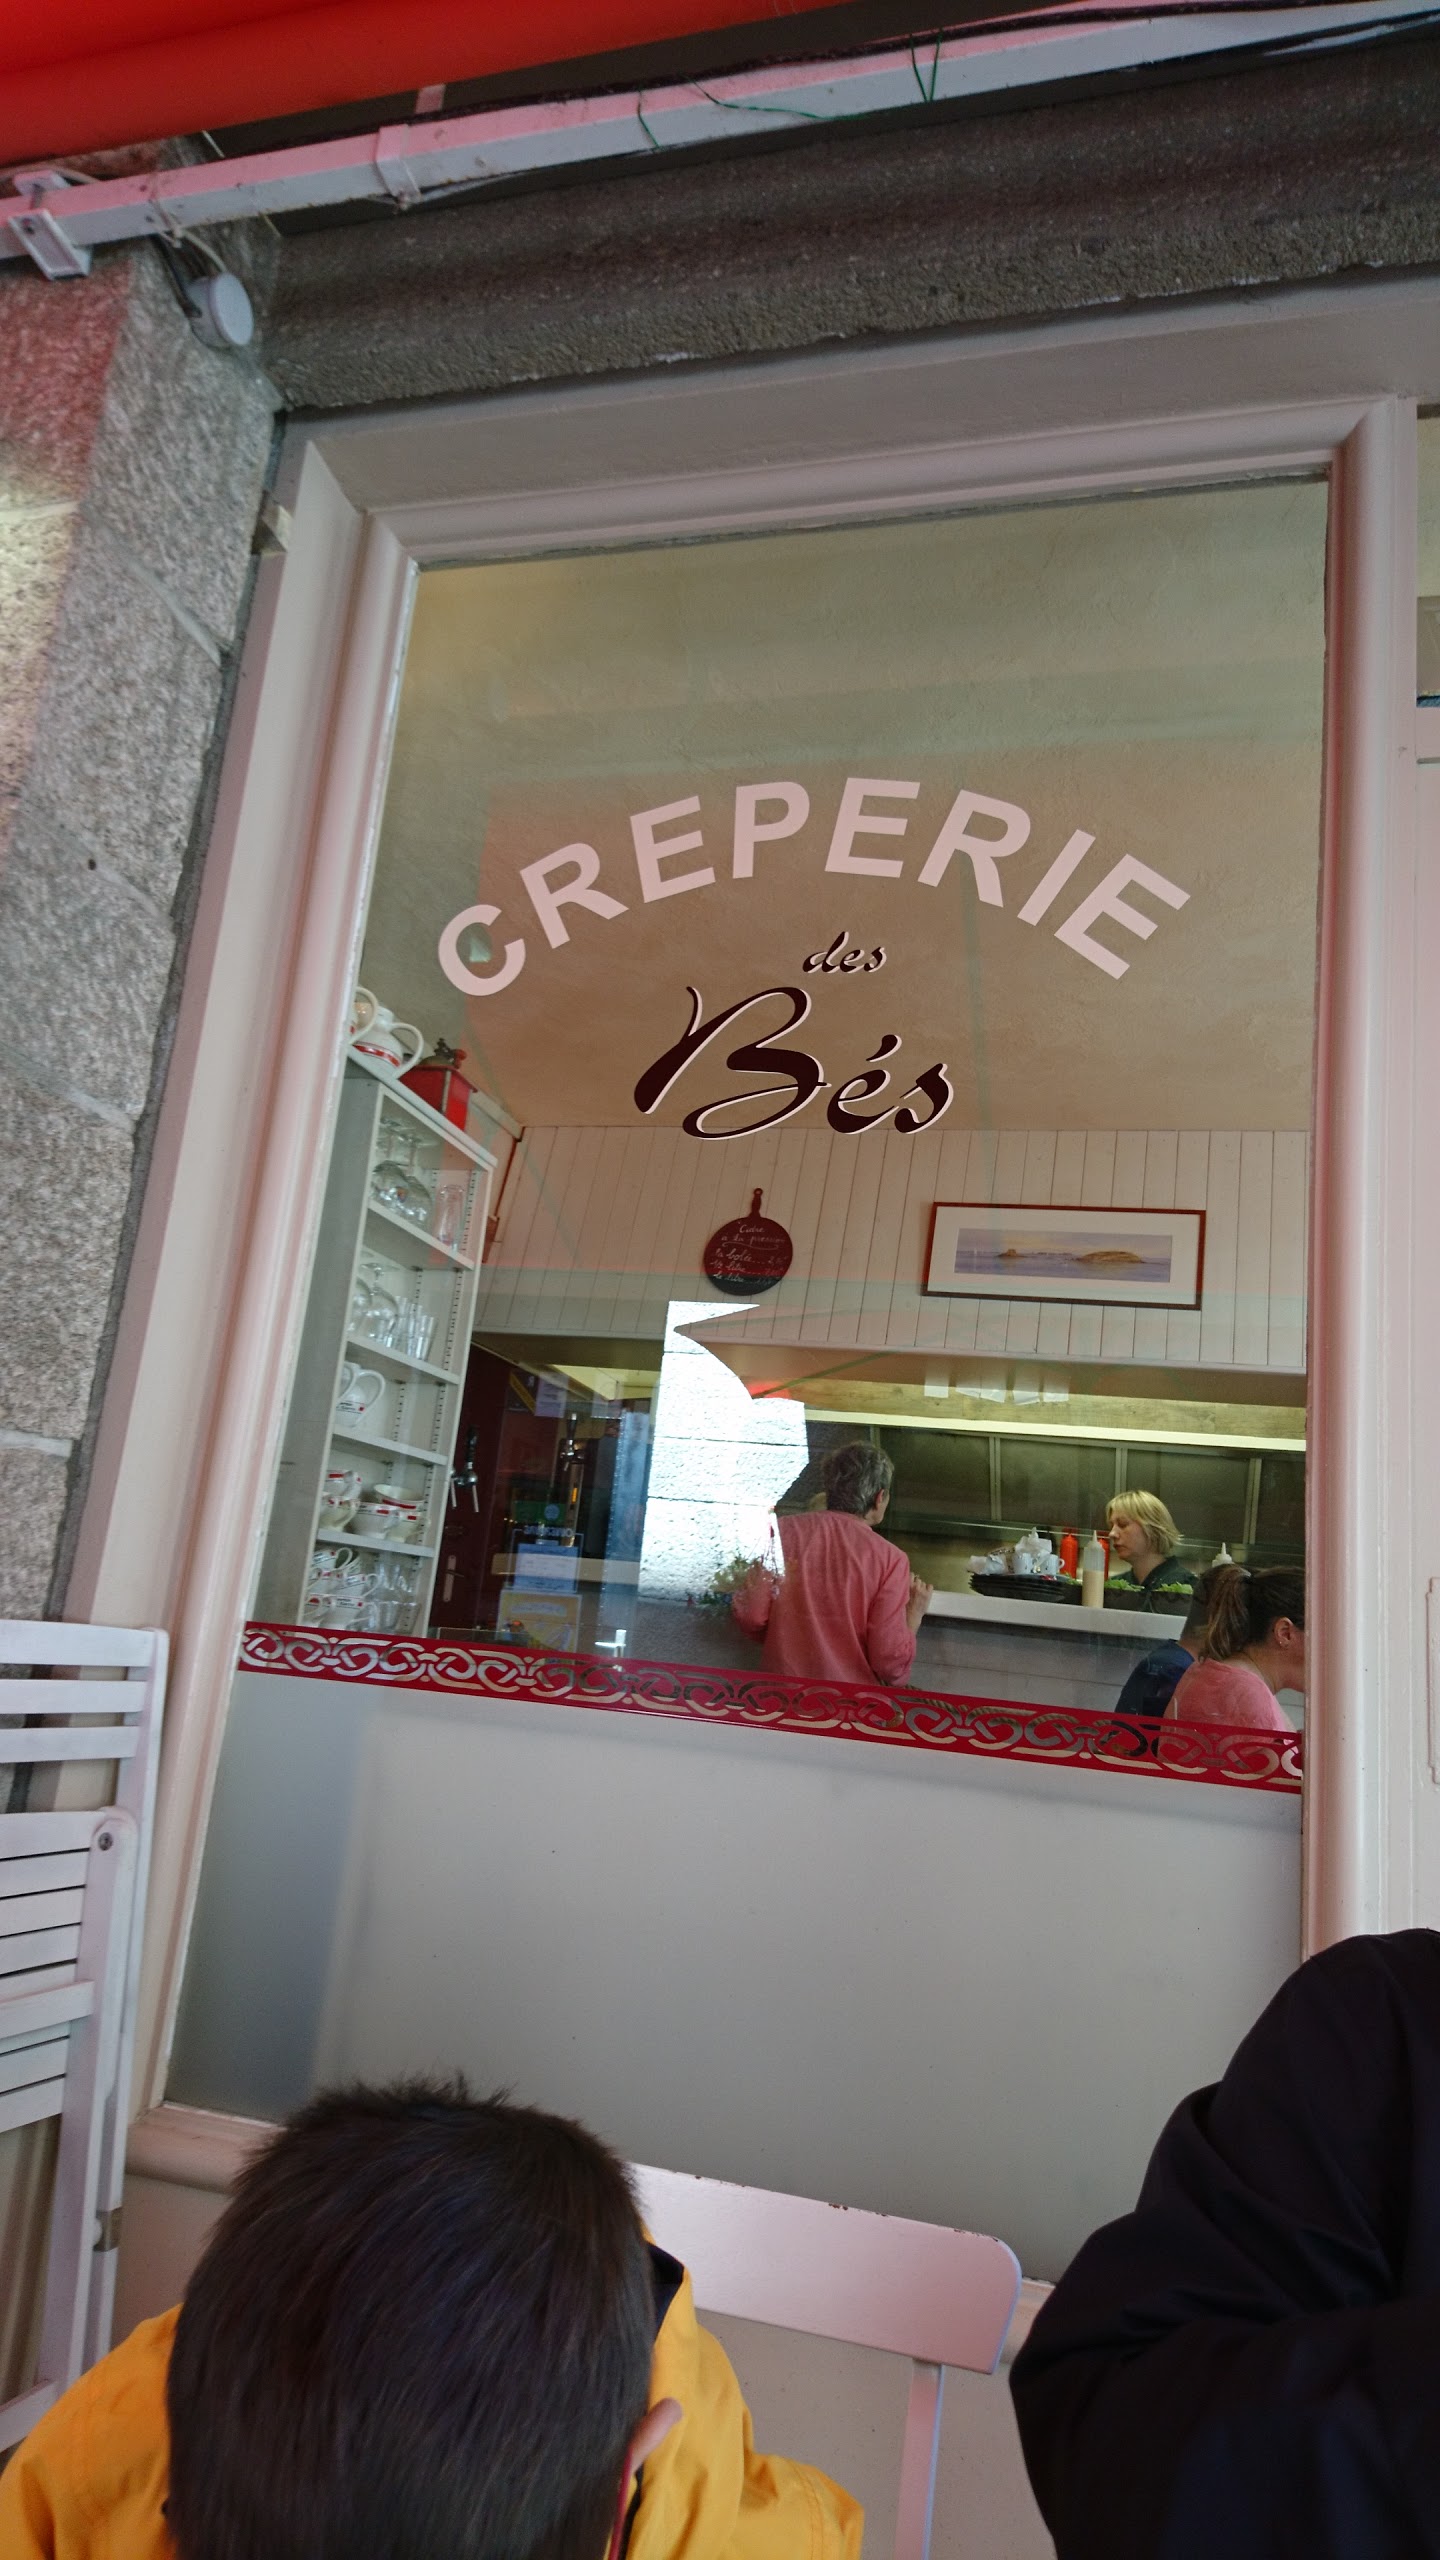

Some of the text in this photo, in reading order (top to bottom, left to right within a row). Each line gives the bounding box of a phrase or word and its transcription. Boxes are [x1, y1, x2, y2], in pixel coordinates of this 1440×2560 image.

[438, 776, 1191, 996] CREPERIE
[802, 931, 887, 974] des
[633, 986, 953, 1140] Bés
